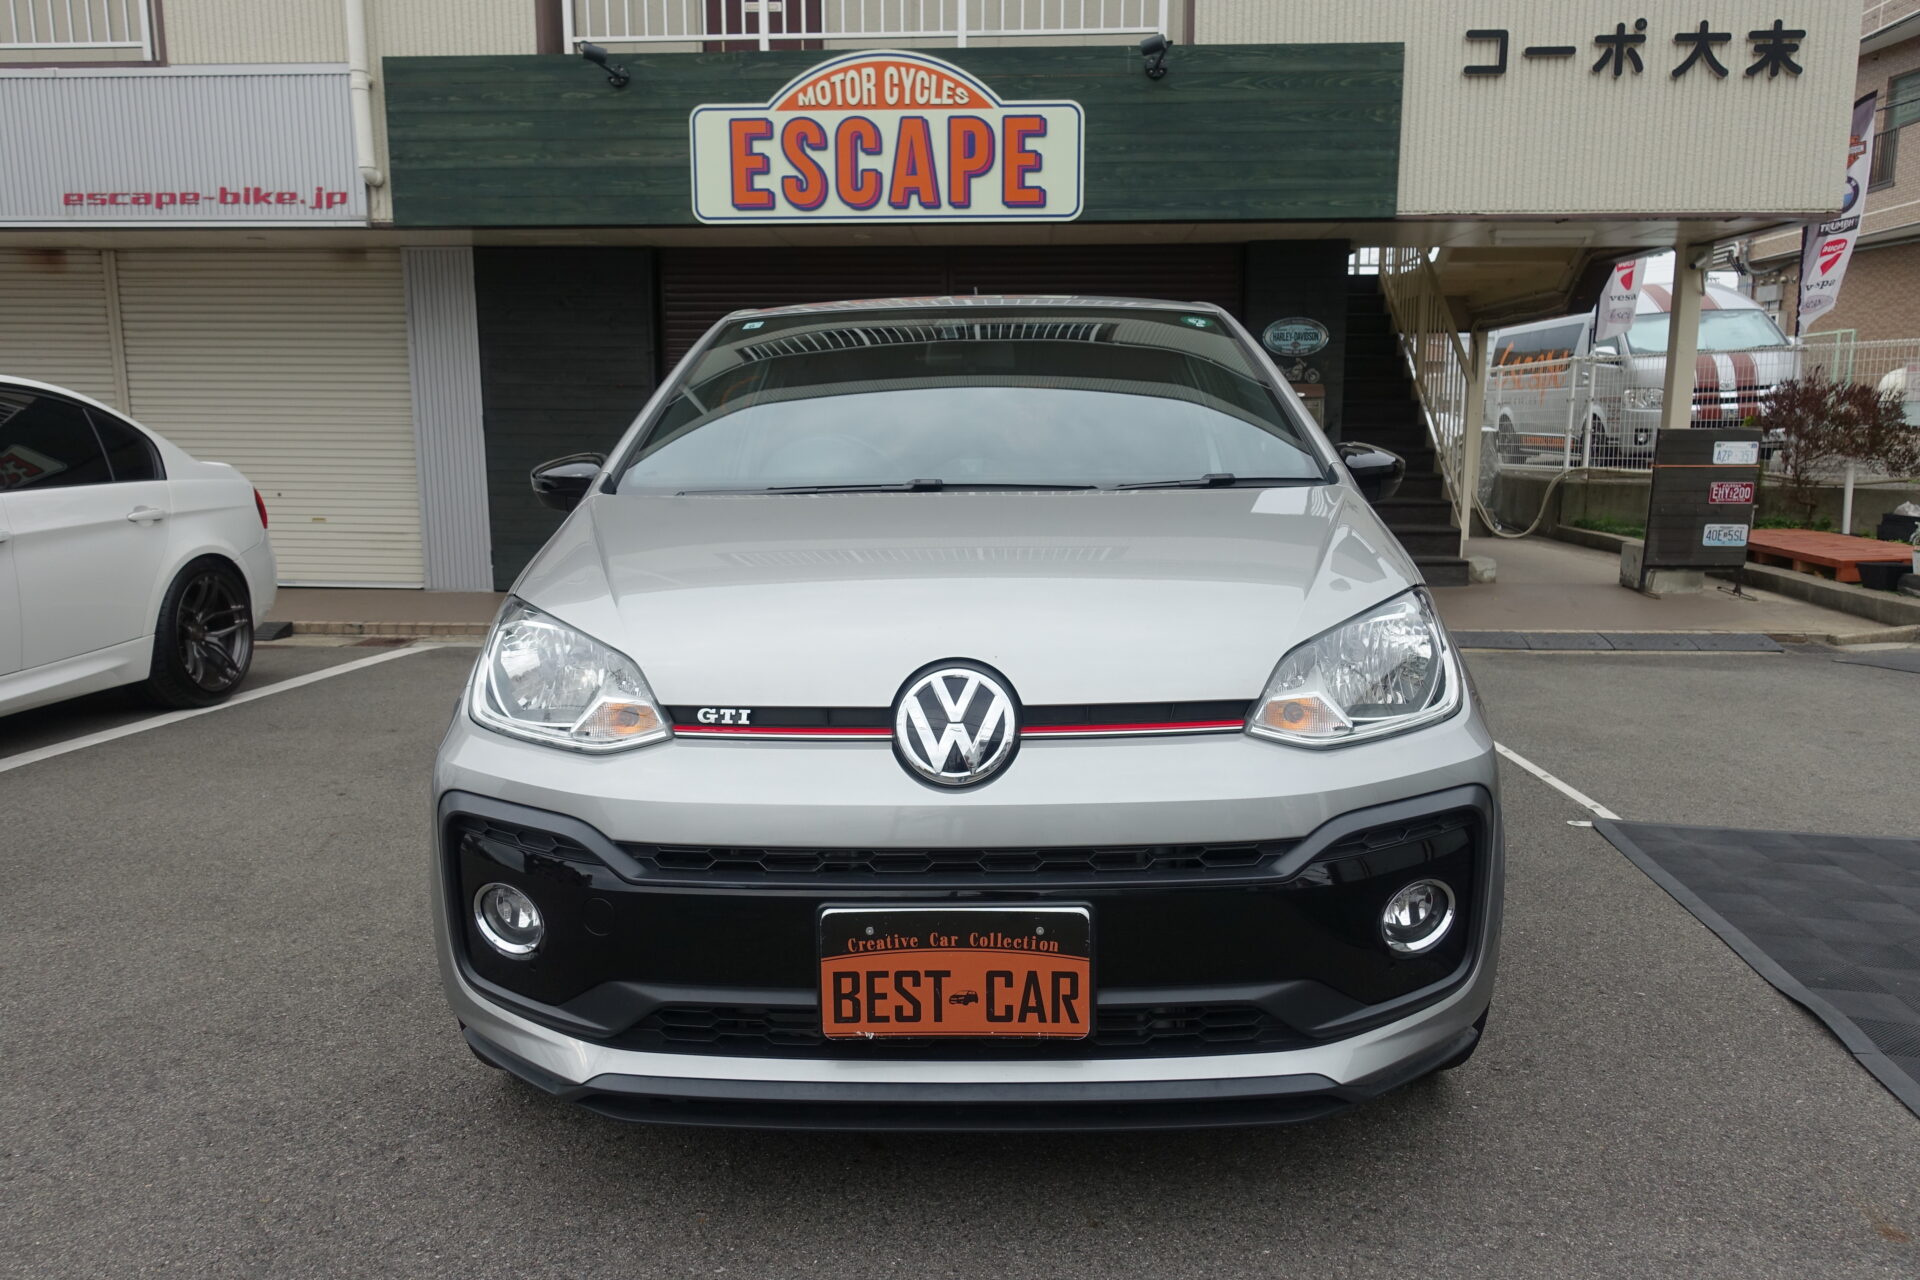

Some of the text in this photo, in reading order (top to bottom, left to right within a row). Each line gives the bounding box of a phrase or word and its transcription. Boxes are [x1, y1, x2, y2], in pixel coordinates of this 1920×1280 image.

[1463, 18, 1807, 77] コーポ大末
[798, 66, 970, 106] MOTOR CYCLES
[729, 115, 1047, 211] ESCAPE
[63, 187, 347, 209] escape-bike.jp
[697, 708, 751, 725] GTI
[848, 932, 1059, 953] Creative Car Collection
[833, 970, 1080, 1024] BEST CAR
